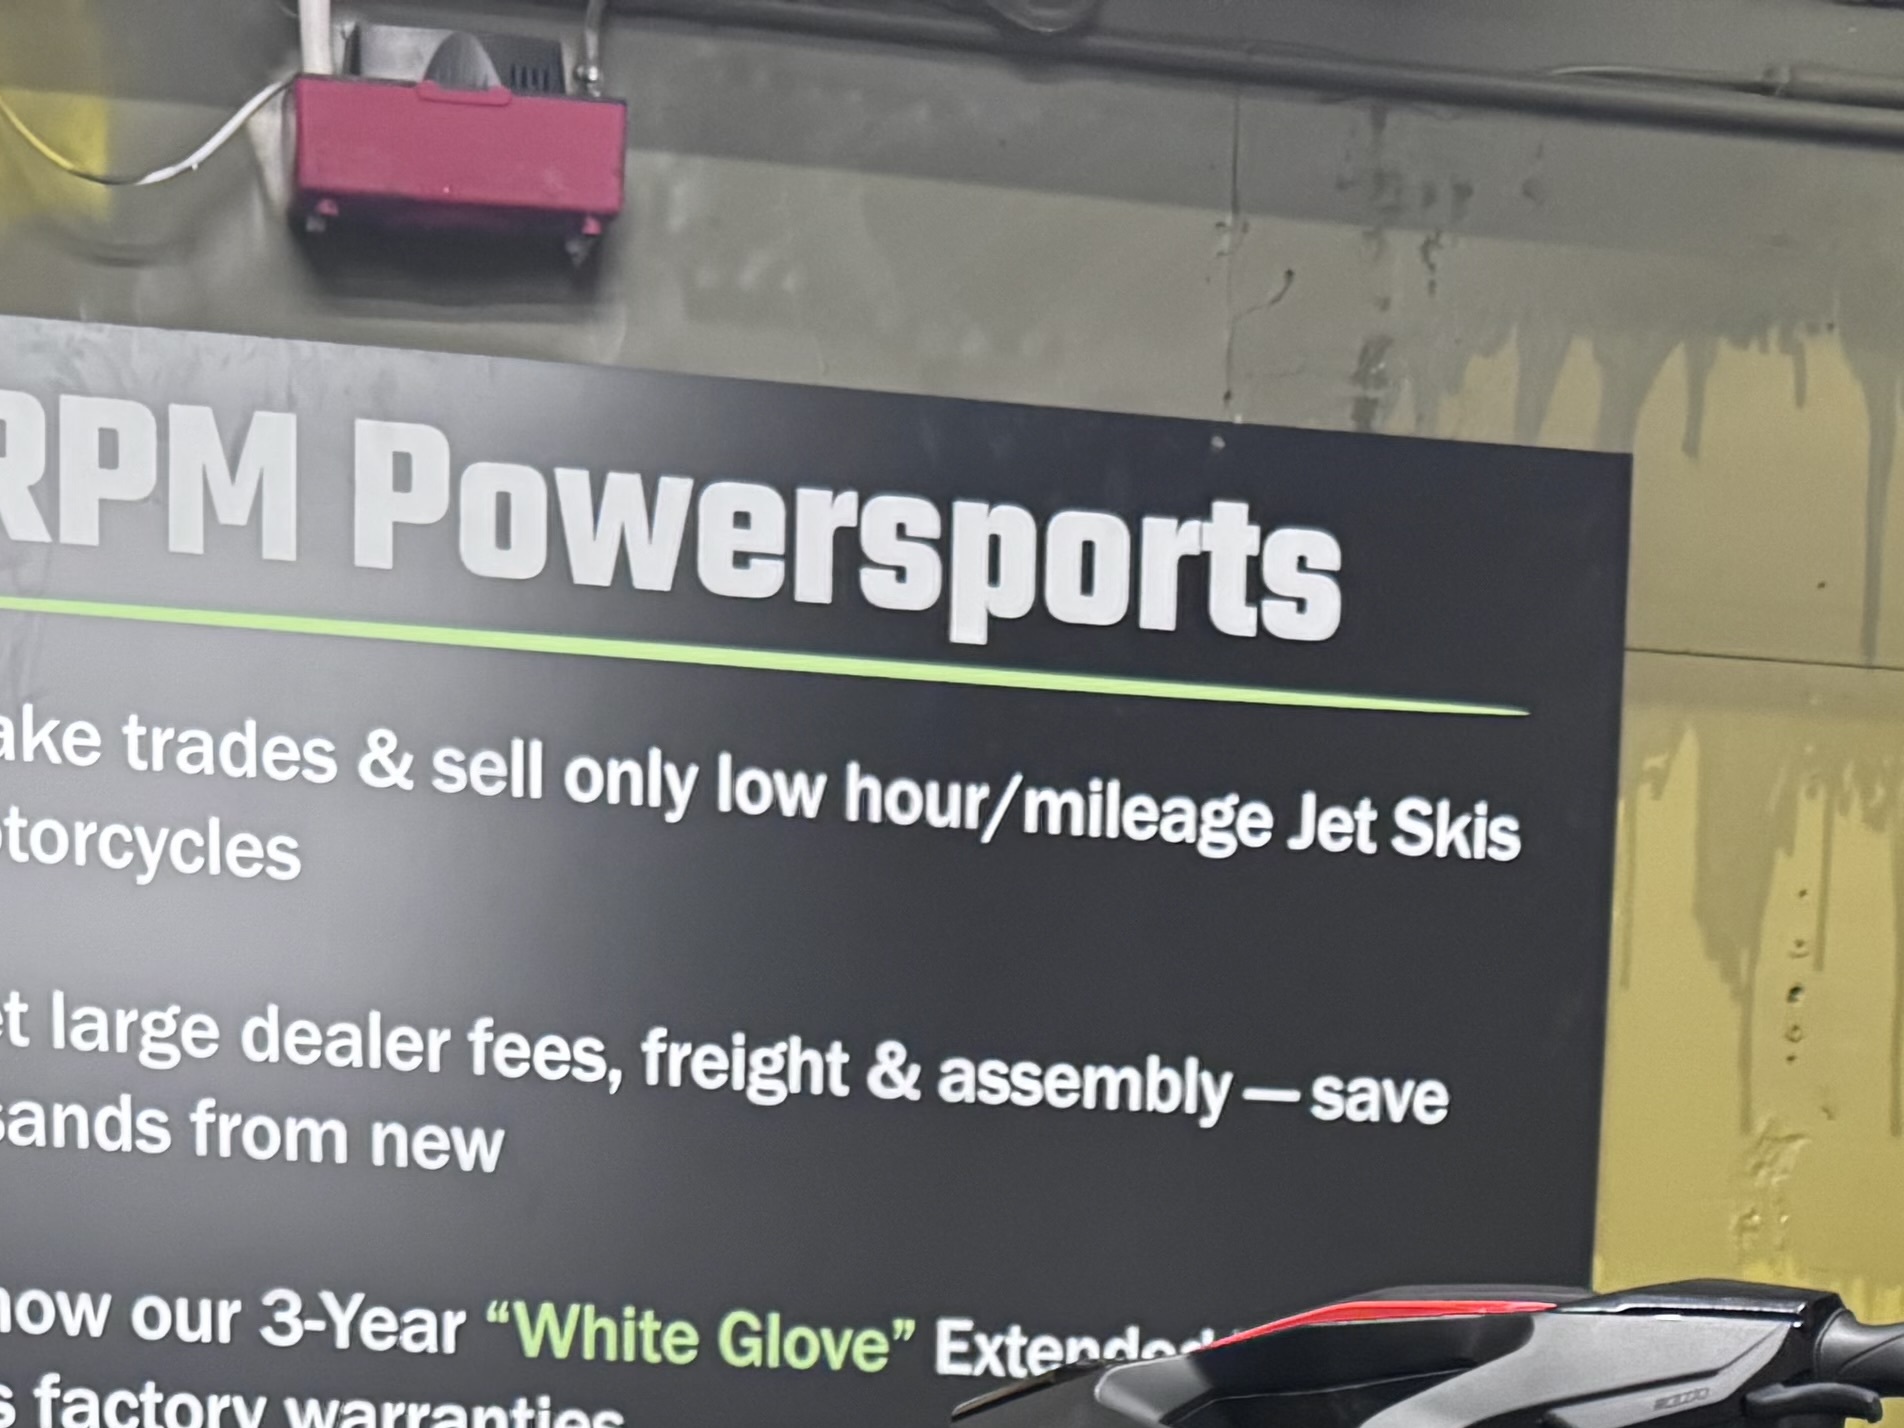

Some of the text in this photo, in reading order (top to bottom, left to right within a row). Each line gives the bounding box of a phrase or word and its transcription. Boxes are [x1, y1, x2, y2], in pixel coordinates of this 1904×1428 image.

[353, 417, 1343, 646] Powersports
[121, 714, 339, 785] trades
[358, 728, 415, 791] &
[431, 738, 544, 799] sell
[564, 746, 701, 824] only
[717, 750, 829, 819] low
[845, 759, 1276, 860] hour/mileage
[1286, 789, 1380, 856] Jet
[1390, 795, 1524, 862] Skis
[52, 989, 220, 1070] large
[241, 1003, 452, 1073] dealer
[466, 1016, 623, 1095] fees,
[640, 1025, 851, 1107] freight
[866, 1039, 922, 1102] &
[189, 1097, 348, 1164] from
[371, 1121, 506, 1173] new
[131, 1294, 242, 1344] our
[258, 1287, 467, 1355] 3-Year
[486, 1299, 700, 1365] “White
[717, 1309, 916, 1373] Glove”
